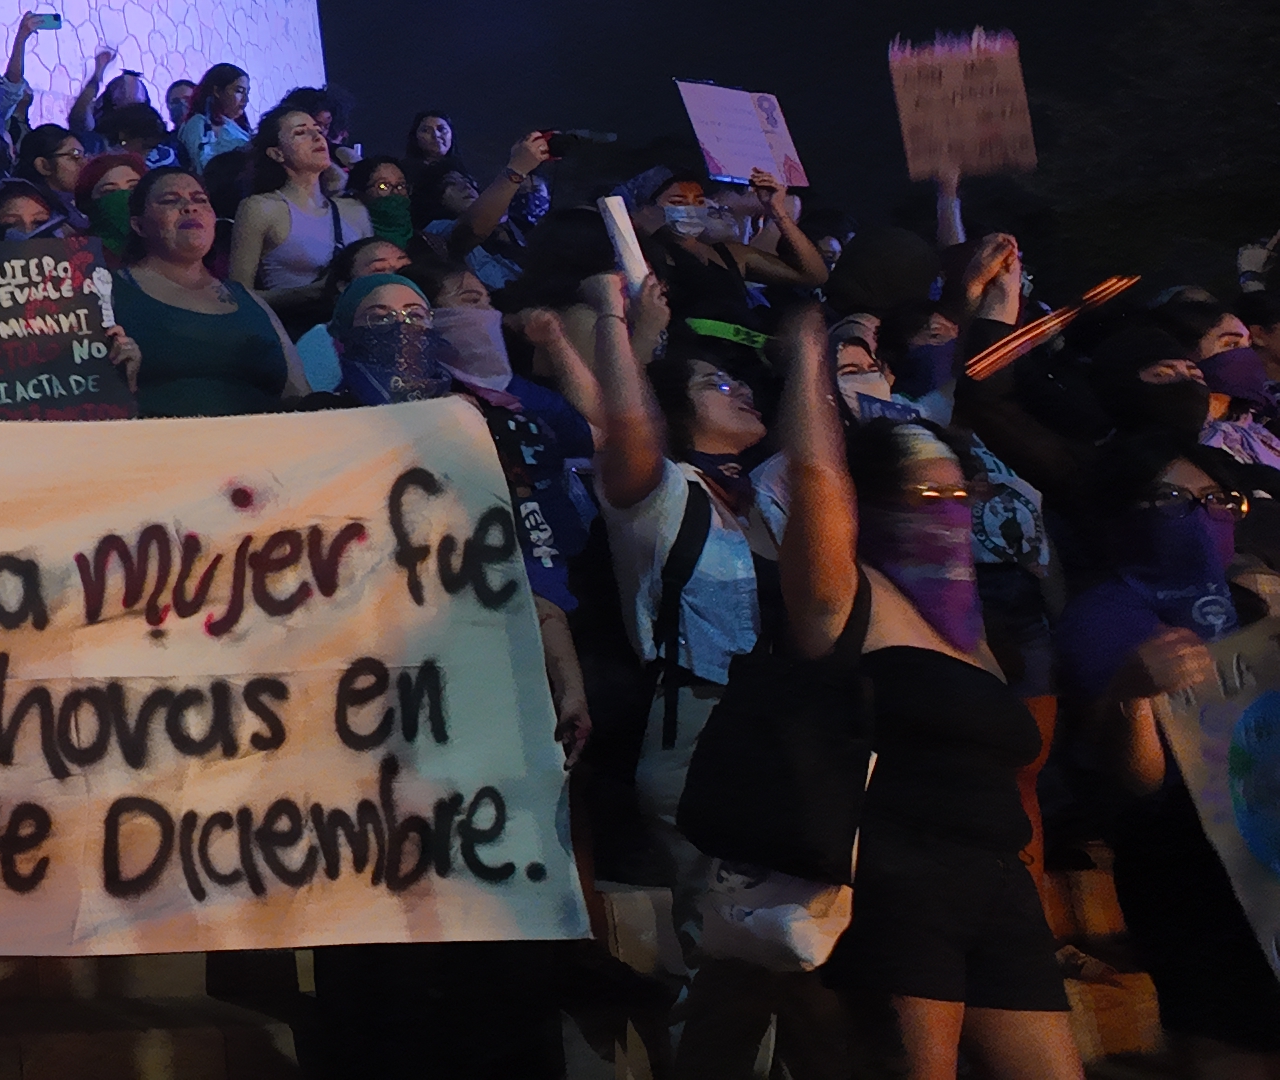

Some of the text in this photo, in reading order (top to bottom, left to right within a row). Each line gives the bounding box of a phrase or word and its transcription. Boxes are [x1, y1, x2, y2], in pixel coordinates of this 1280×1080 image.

[71, 338, 108, 365] NO
[14, 373, 68, 403] ACTA
[68, 374, 100, 396] DE
[73, 483, 370, 639] mujer
[388, 466, 523, 610] fue
[335, 656, 450, 752] en
